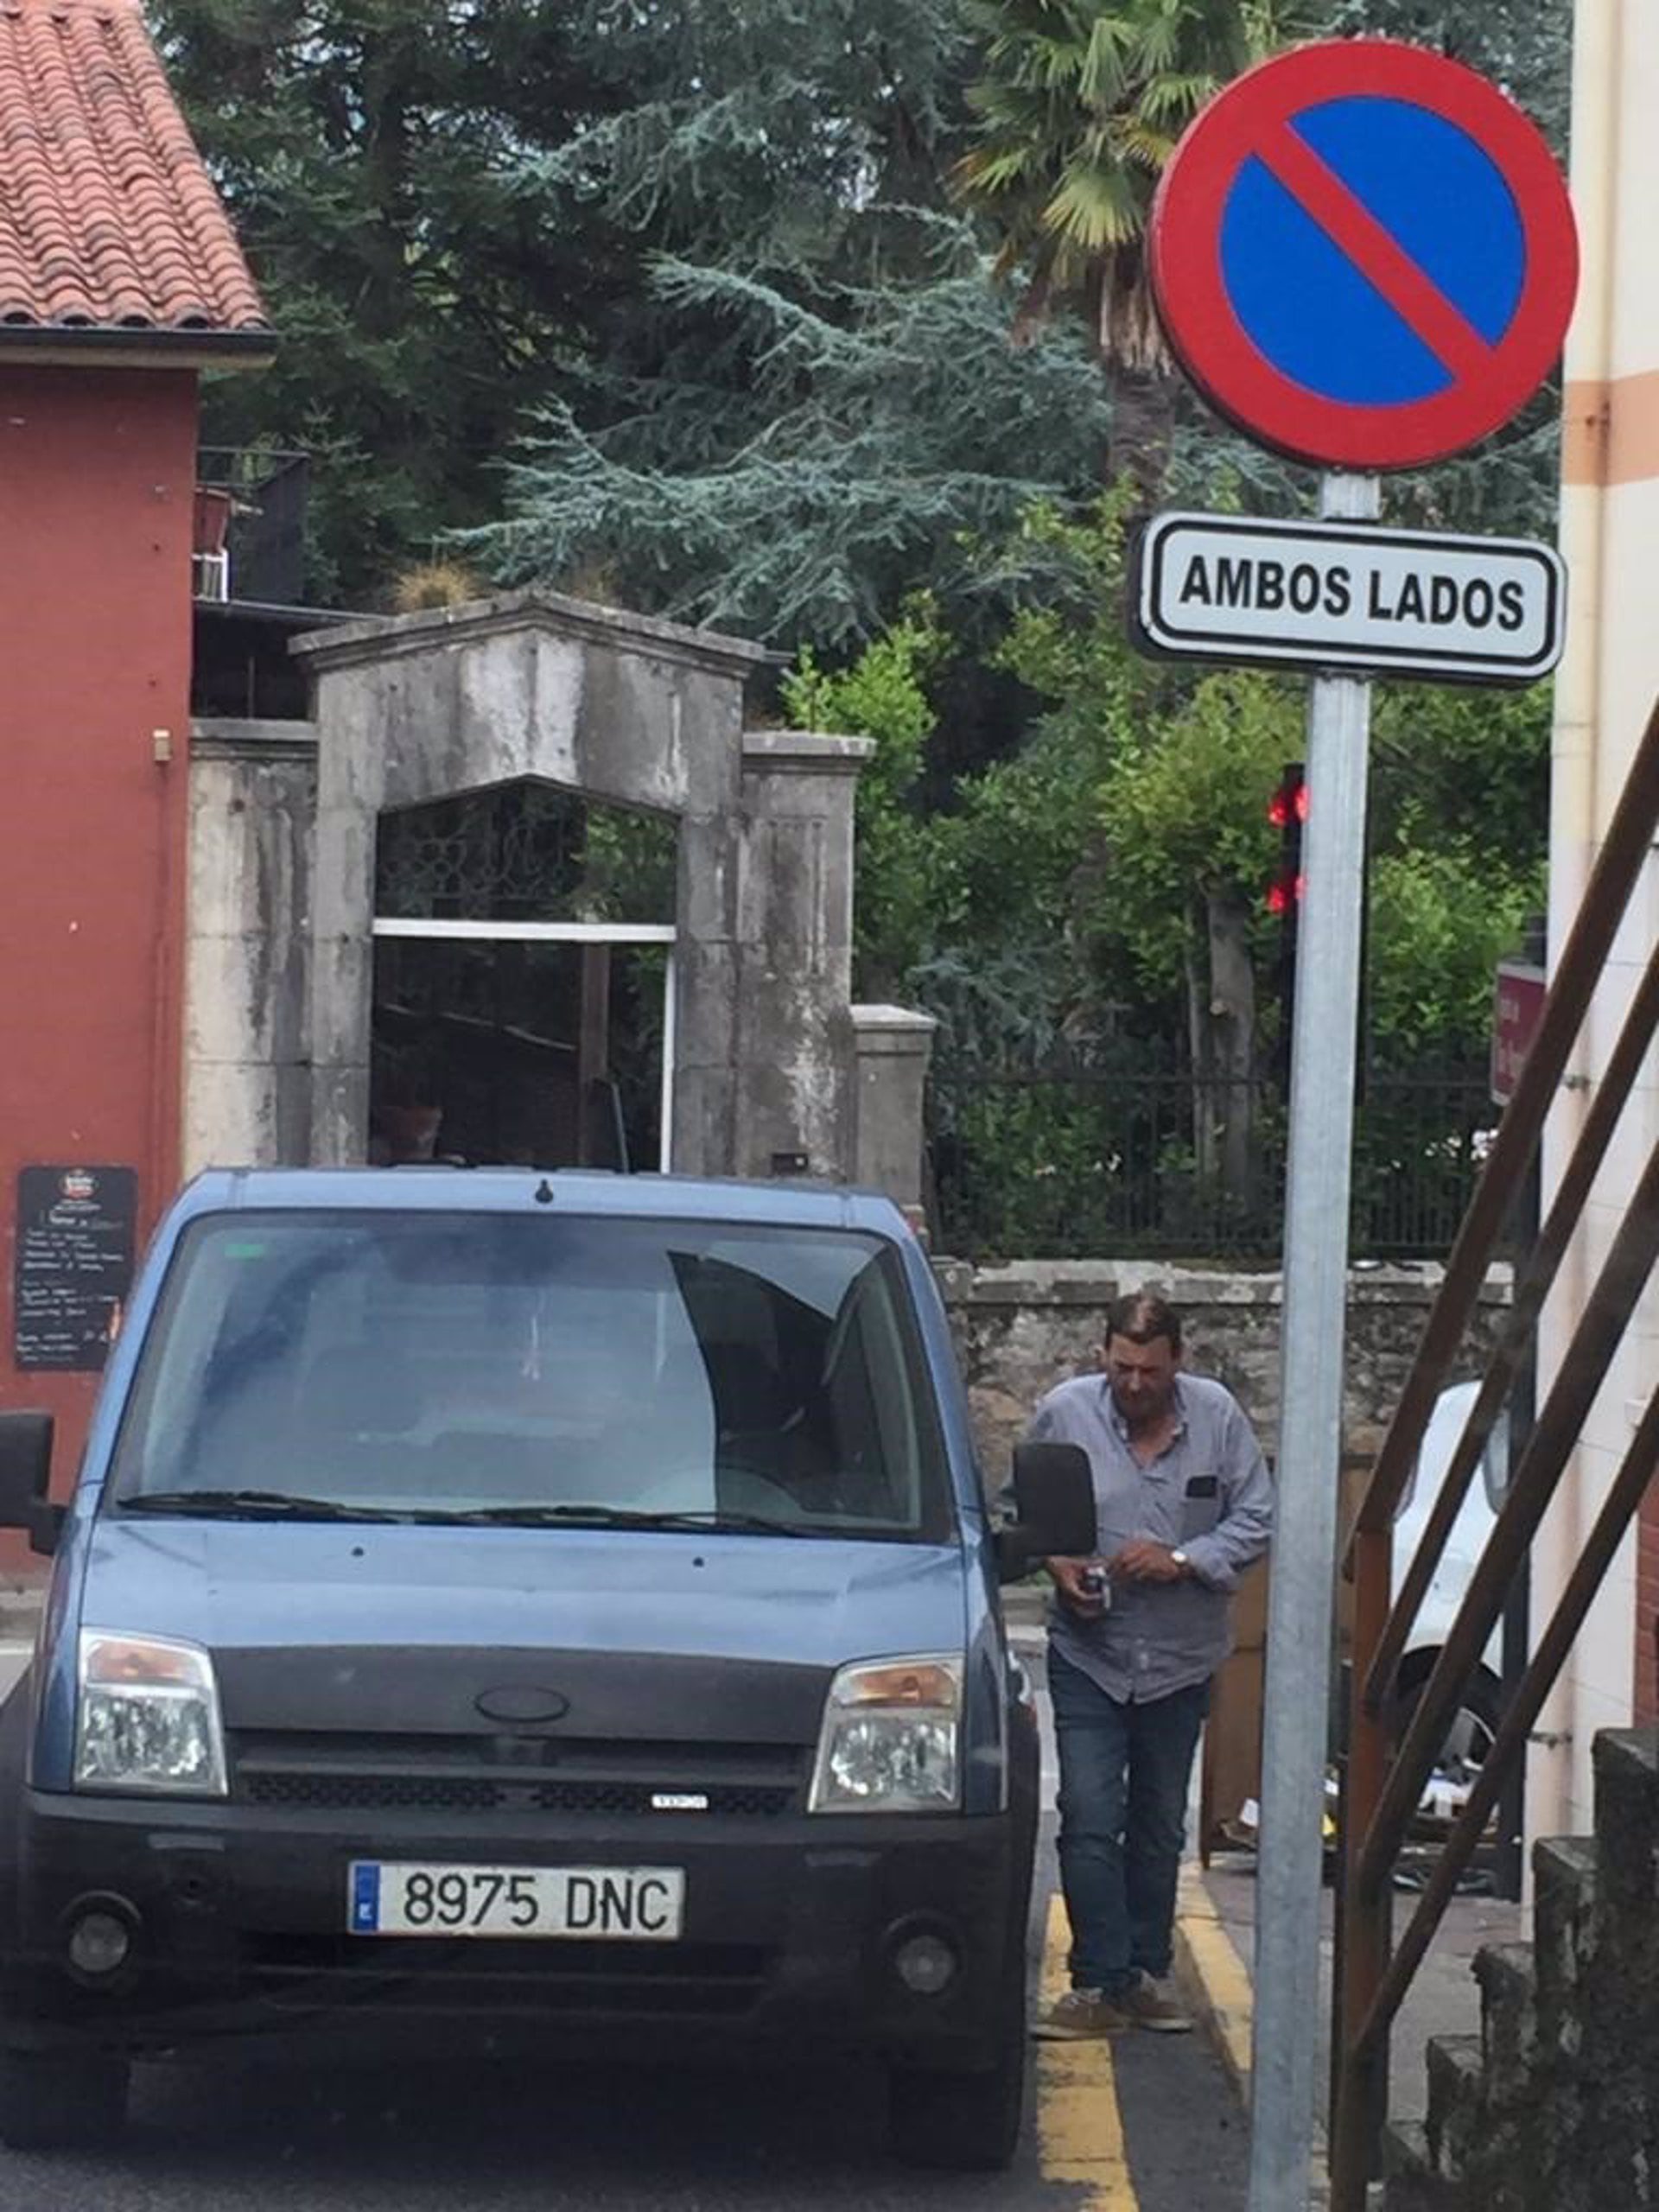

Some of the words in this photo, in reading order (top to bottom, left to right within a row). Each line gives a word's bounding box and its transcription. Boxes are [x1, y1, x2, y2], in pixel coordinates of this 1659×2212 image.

[1179, 555, 1351, 617] AMBOS
[1368, 569, 1524, 631] LADOS
[403, 1872, 538, 1927] 8975
[565, 1876, 669, 1930] DNC
